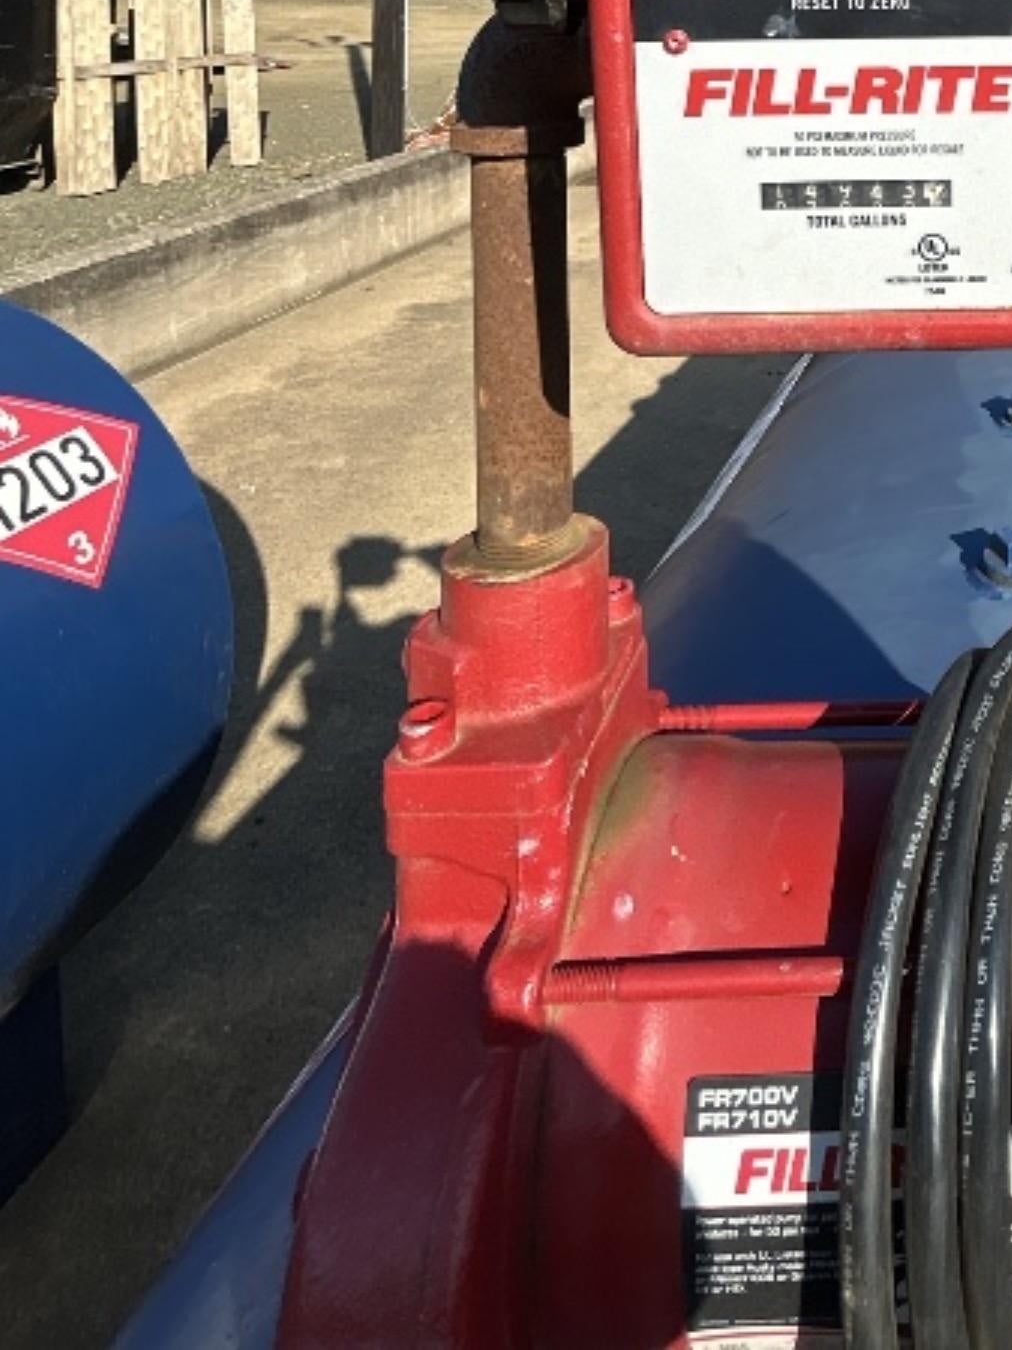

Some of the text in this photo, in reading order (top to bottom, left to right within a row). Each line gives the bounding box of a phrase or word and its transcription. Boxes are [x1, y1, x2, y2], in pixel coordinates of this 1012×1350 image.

[806, 213, 907, 229] TOTAL GALLONS
[67, 529, 96, 565] 3
[699, 1086, 799, 1108] FR700V
[699, 1109, 799, 1131] FR710V
